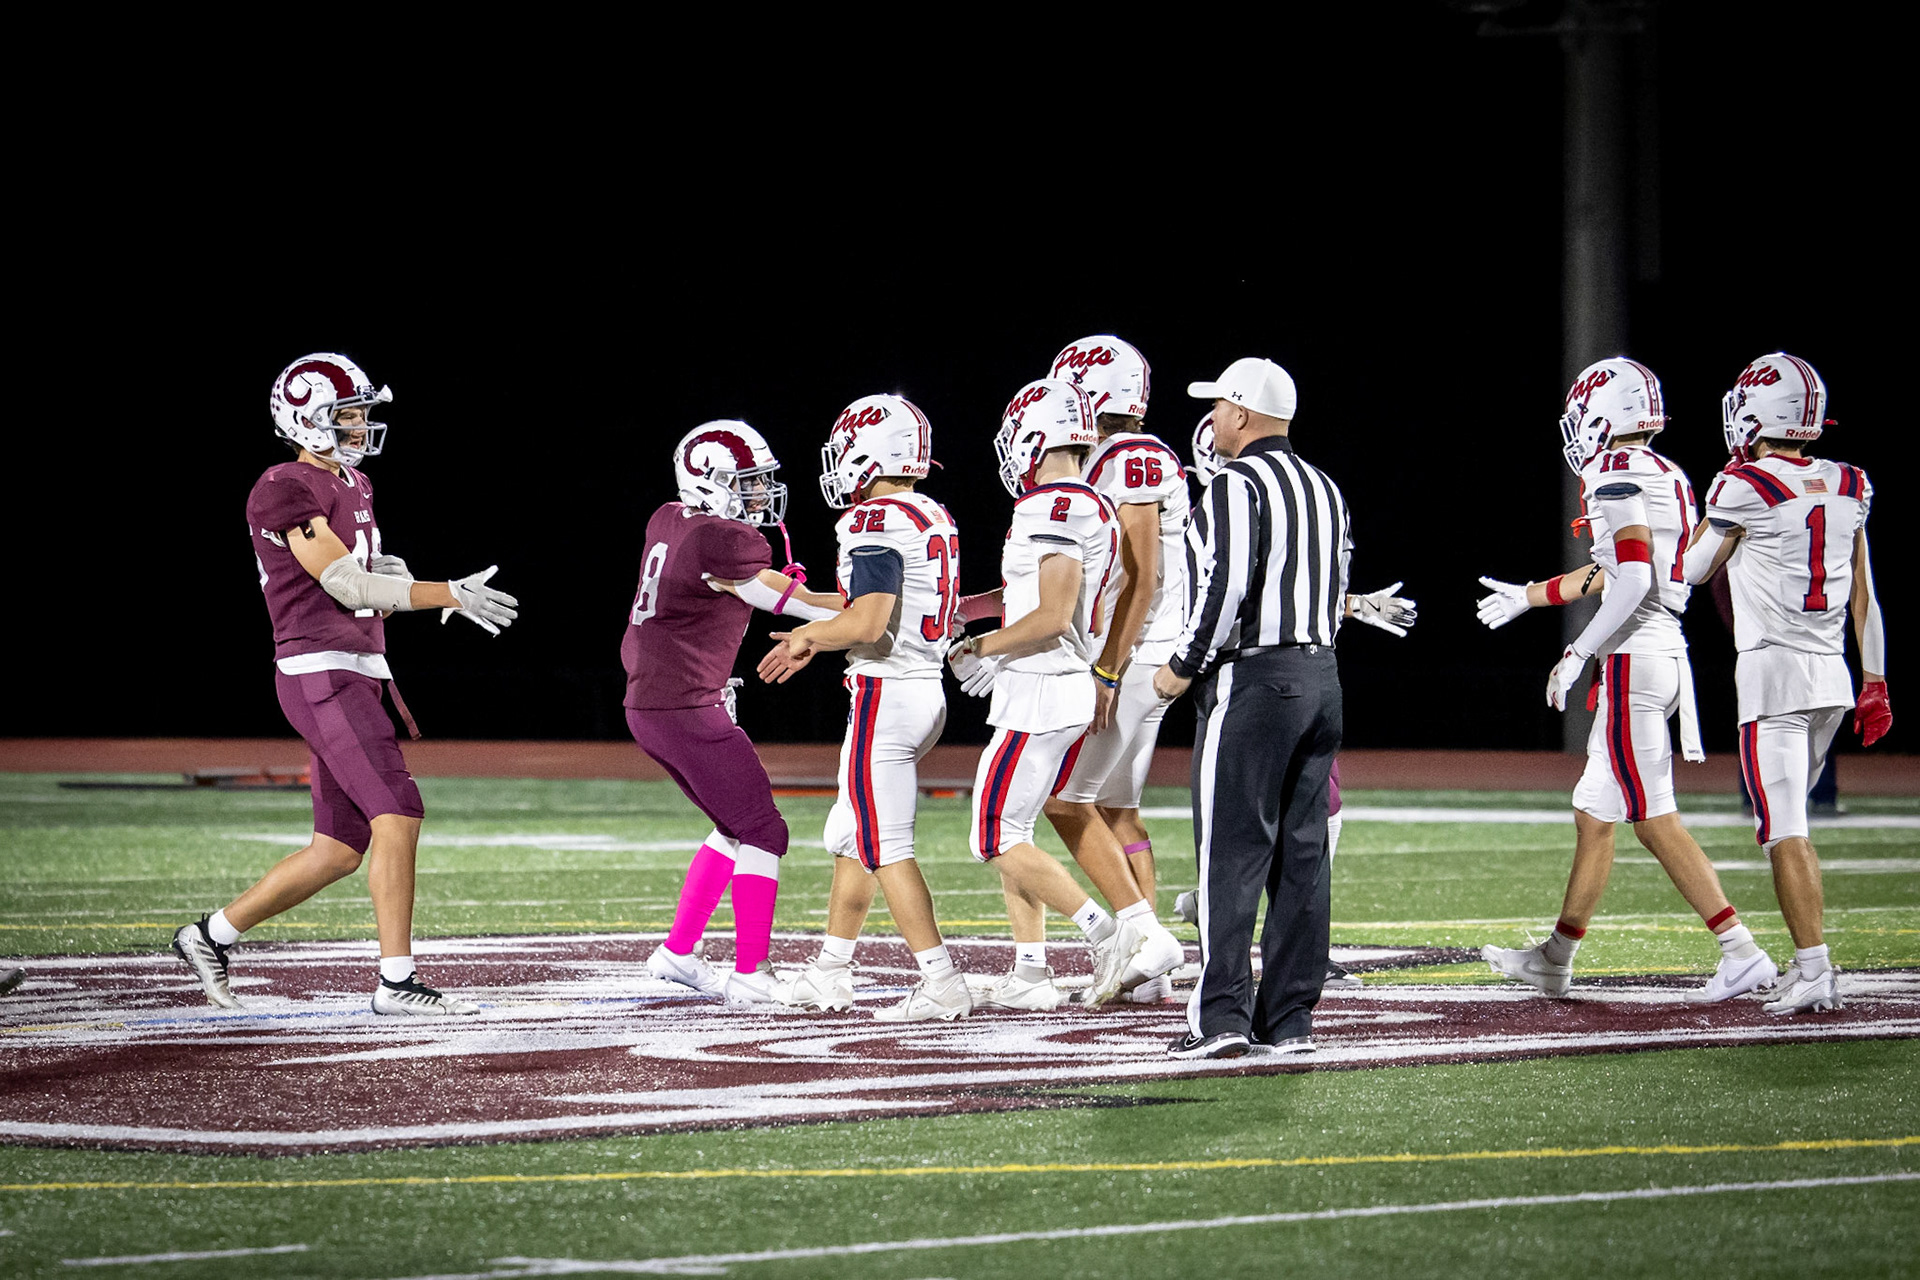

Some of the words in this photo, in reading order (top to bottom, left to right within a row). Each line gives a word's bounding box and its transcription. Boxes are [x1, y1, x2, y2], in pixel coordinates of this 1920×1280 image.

[1053, 346, 1115, 378] Pats
[1001, 386, 1047, 424] ats
[1125, 457, 1163, 489] 66
[1599, 451, 1630, 473] 12
[849, 508, 886, 534] 32
[1050, 496, 1072, 522] 2
[1802, 504, 1829, 613] 1
[632, 541, 669, 626] 8
